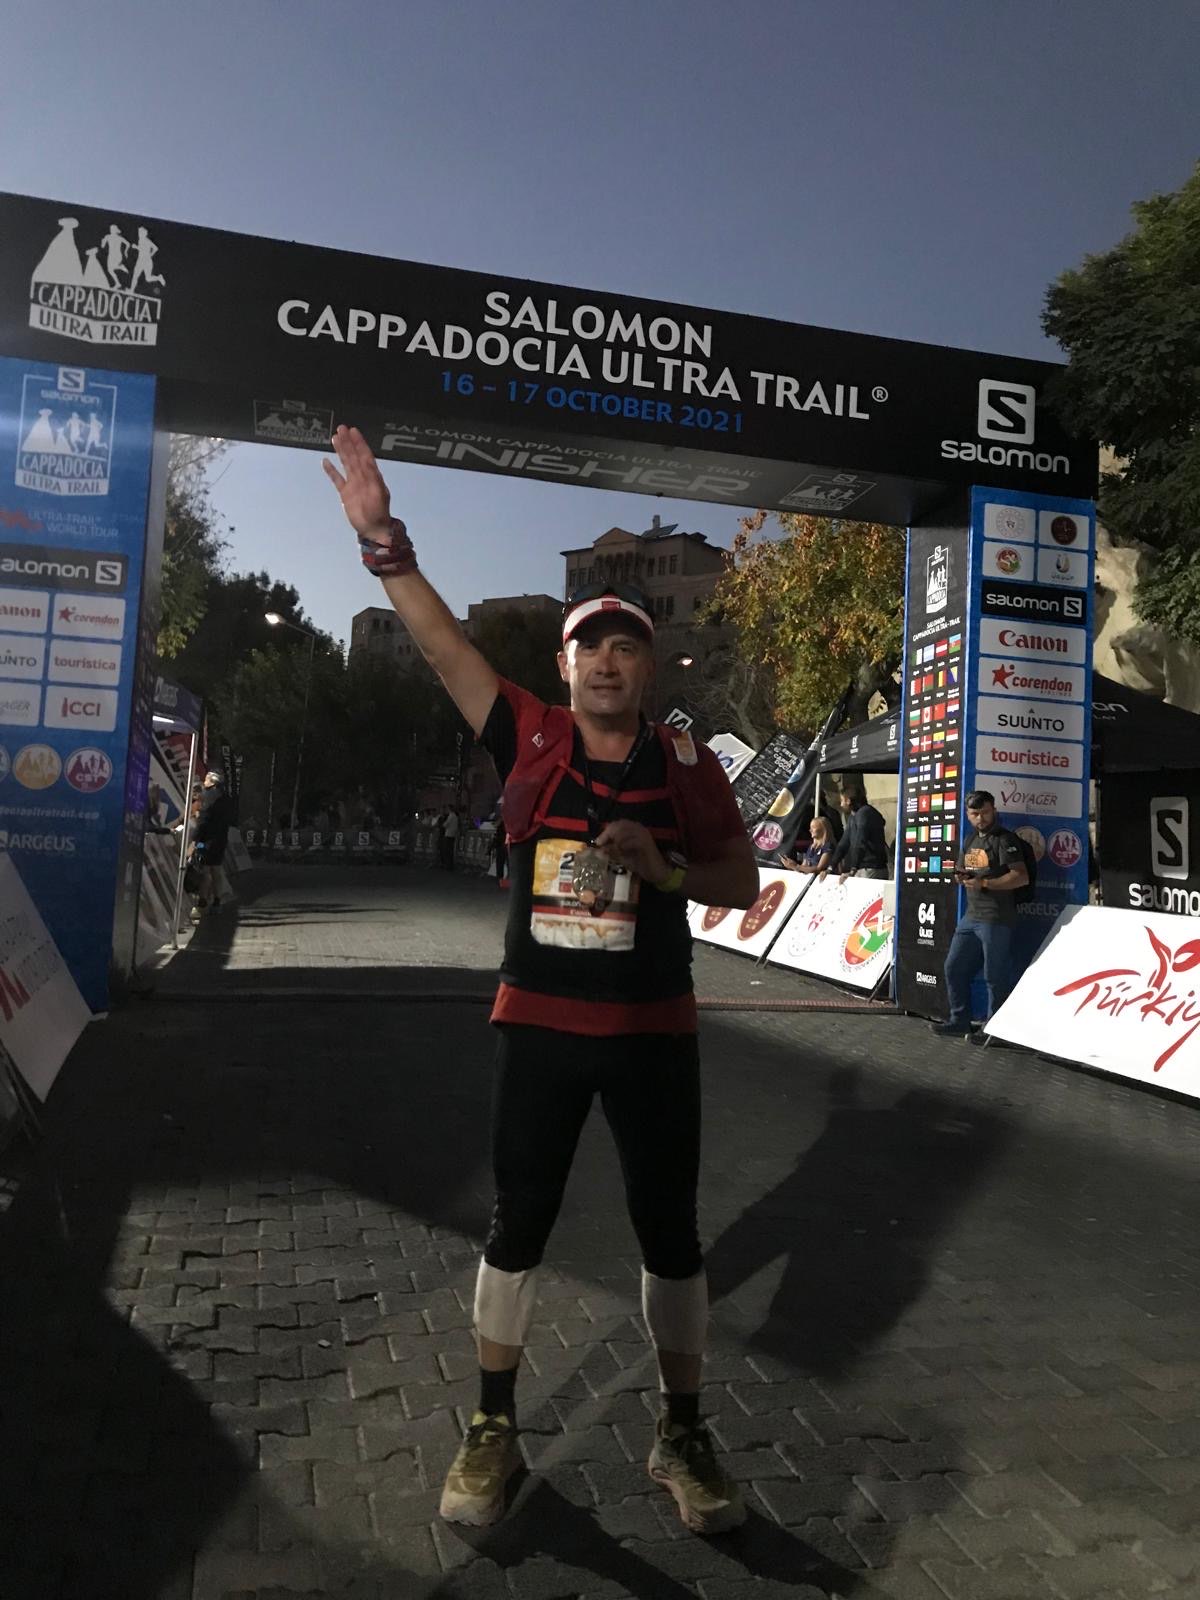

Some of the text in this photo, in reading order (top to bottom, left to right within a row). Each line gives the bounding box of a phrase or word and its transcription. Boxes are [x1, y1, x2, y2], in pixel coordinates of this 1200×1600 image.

[37, 284, 152, 322] CAPPADOCIA
[38, 308, 149, 343] ULTRA TRAIL
[483, 291, 712, 358] SALOMON
[276, 299, 592, 379] CAPPADOCIA
[601, 348, 742, 402] ULTRA
[441, 371, 475, 396] 16
[508, 380, 540, 404] 17
[546, 386, 673, 425] OCTOBER
[679, 405, 743, 433] 2021
[384, 422, 491, 444] SALOMON
[495, 438, 627, 463] CAPPADOCIA
[22, 454, 104, 477] CAPPADOCIA
[381, 434, 750, 496] FINISHER
[940, 439, 1070, 475] salomon
[23, 473, 102, 494] ULTRA TRAIL
[986, 593, 1060, 612] salomon
[73, 613, 120, 626] corendon
[998, 629, 1068, 653] Canon
[54, 655, 117, 671] touristica
[1012, 675, 1073, 692] corendon
[997, 713, 1065, 732] SUUNTO
[991, 747, 1070, 768] touristica
[1001, 787, 1058, 806] VOYAGER
[9, 832, 76, 851] ARGEUS
[917, 902, 936, 925] 64
